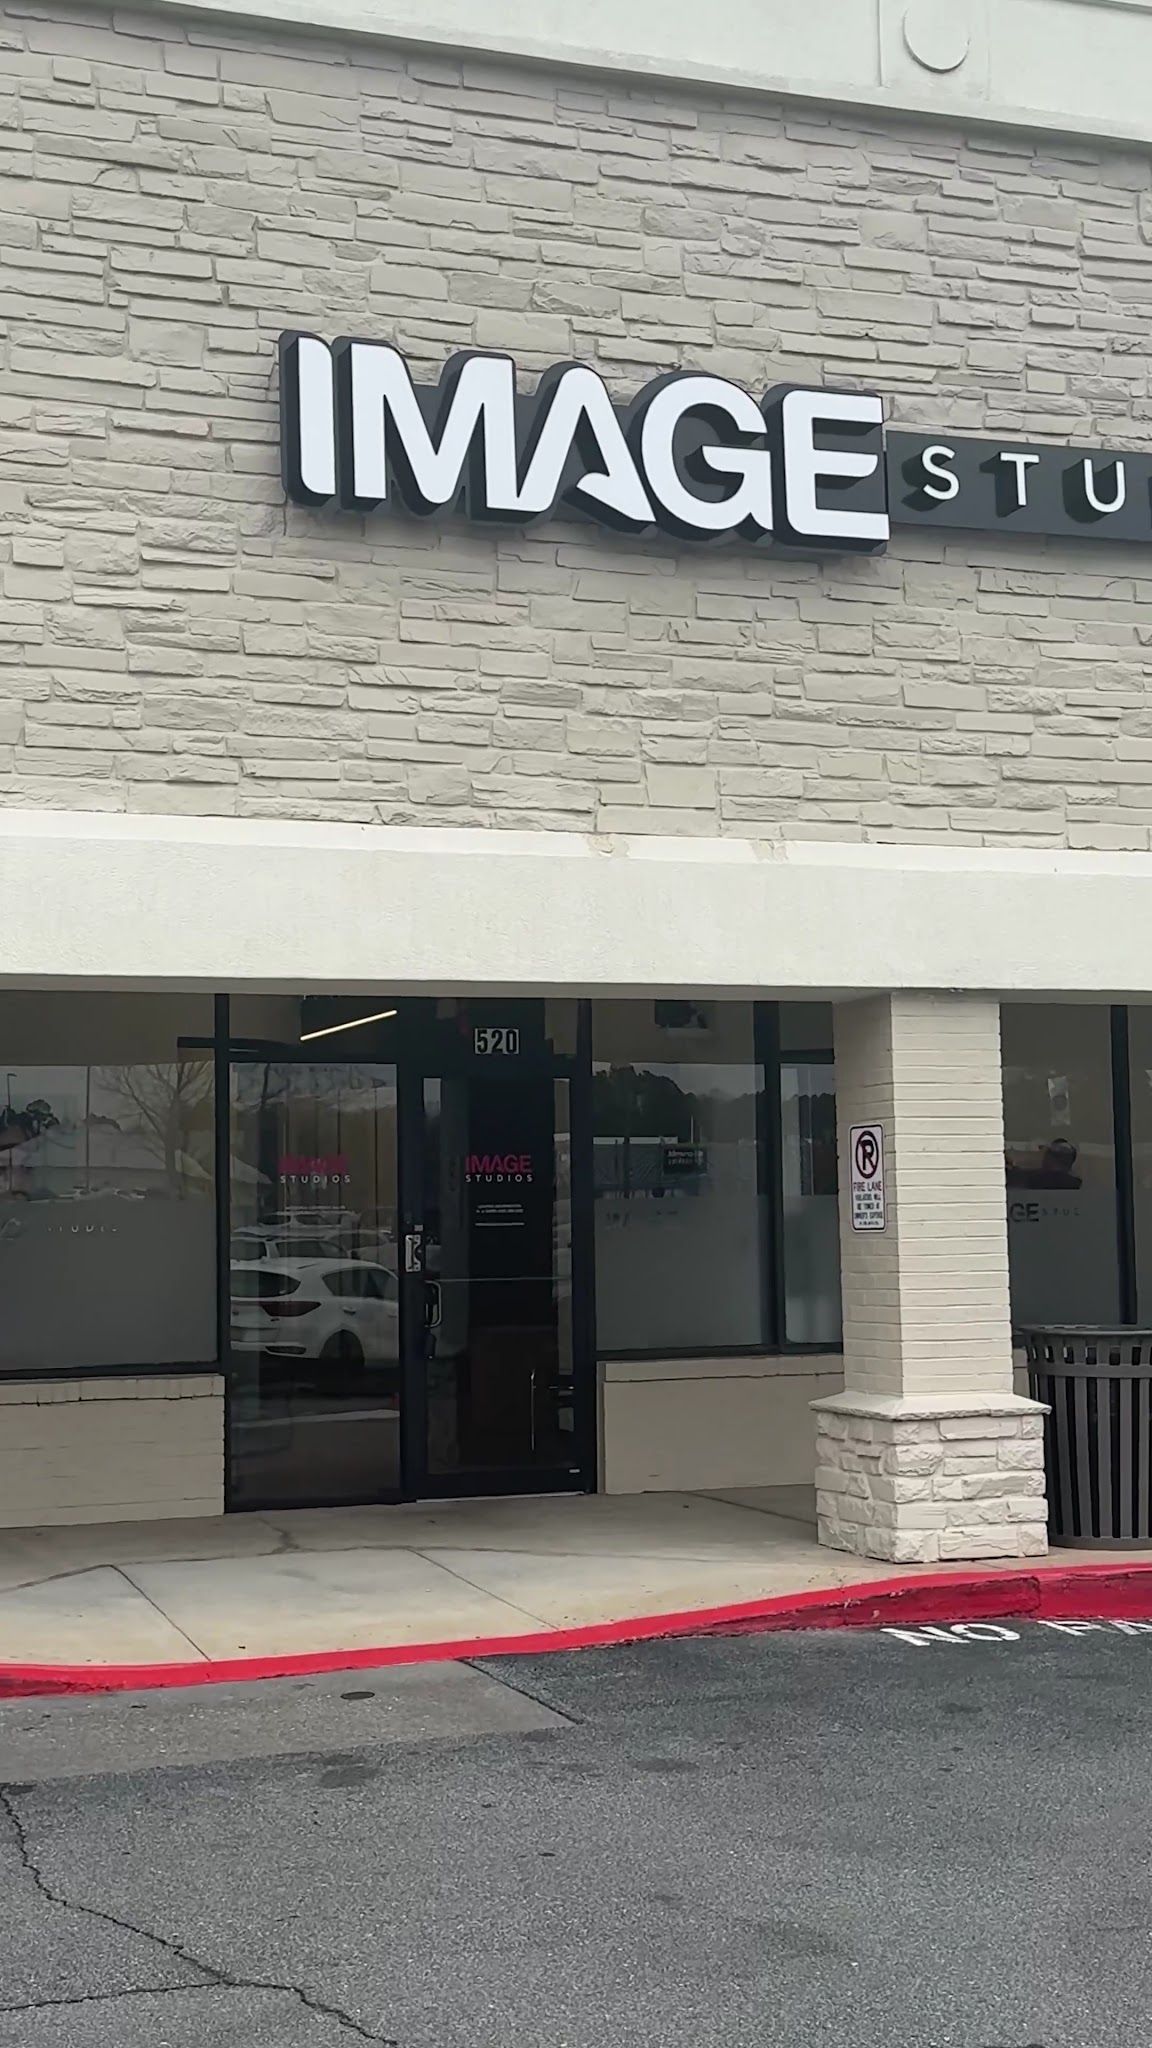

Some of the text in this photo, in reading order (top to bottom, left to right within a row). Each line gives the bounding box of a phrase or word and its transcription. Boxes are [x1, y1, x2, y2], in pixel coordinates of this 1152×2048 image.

[297, 336, 890, 541] IMAGE
[475, 1029, 519, 1054] 520
[465, 1154, 532, 1173] IMAGE
[279, 1174, 351, 1184] STUDIOS
[465, 1174, 534, 1183] STUDIOS
[880, 1623, 1020, 1647] NO
